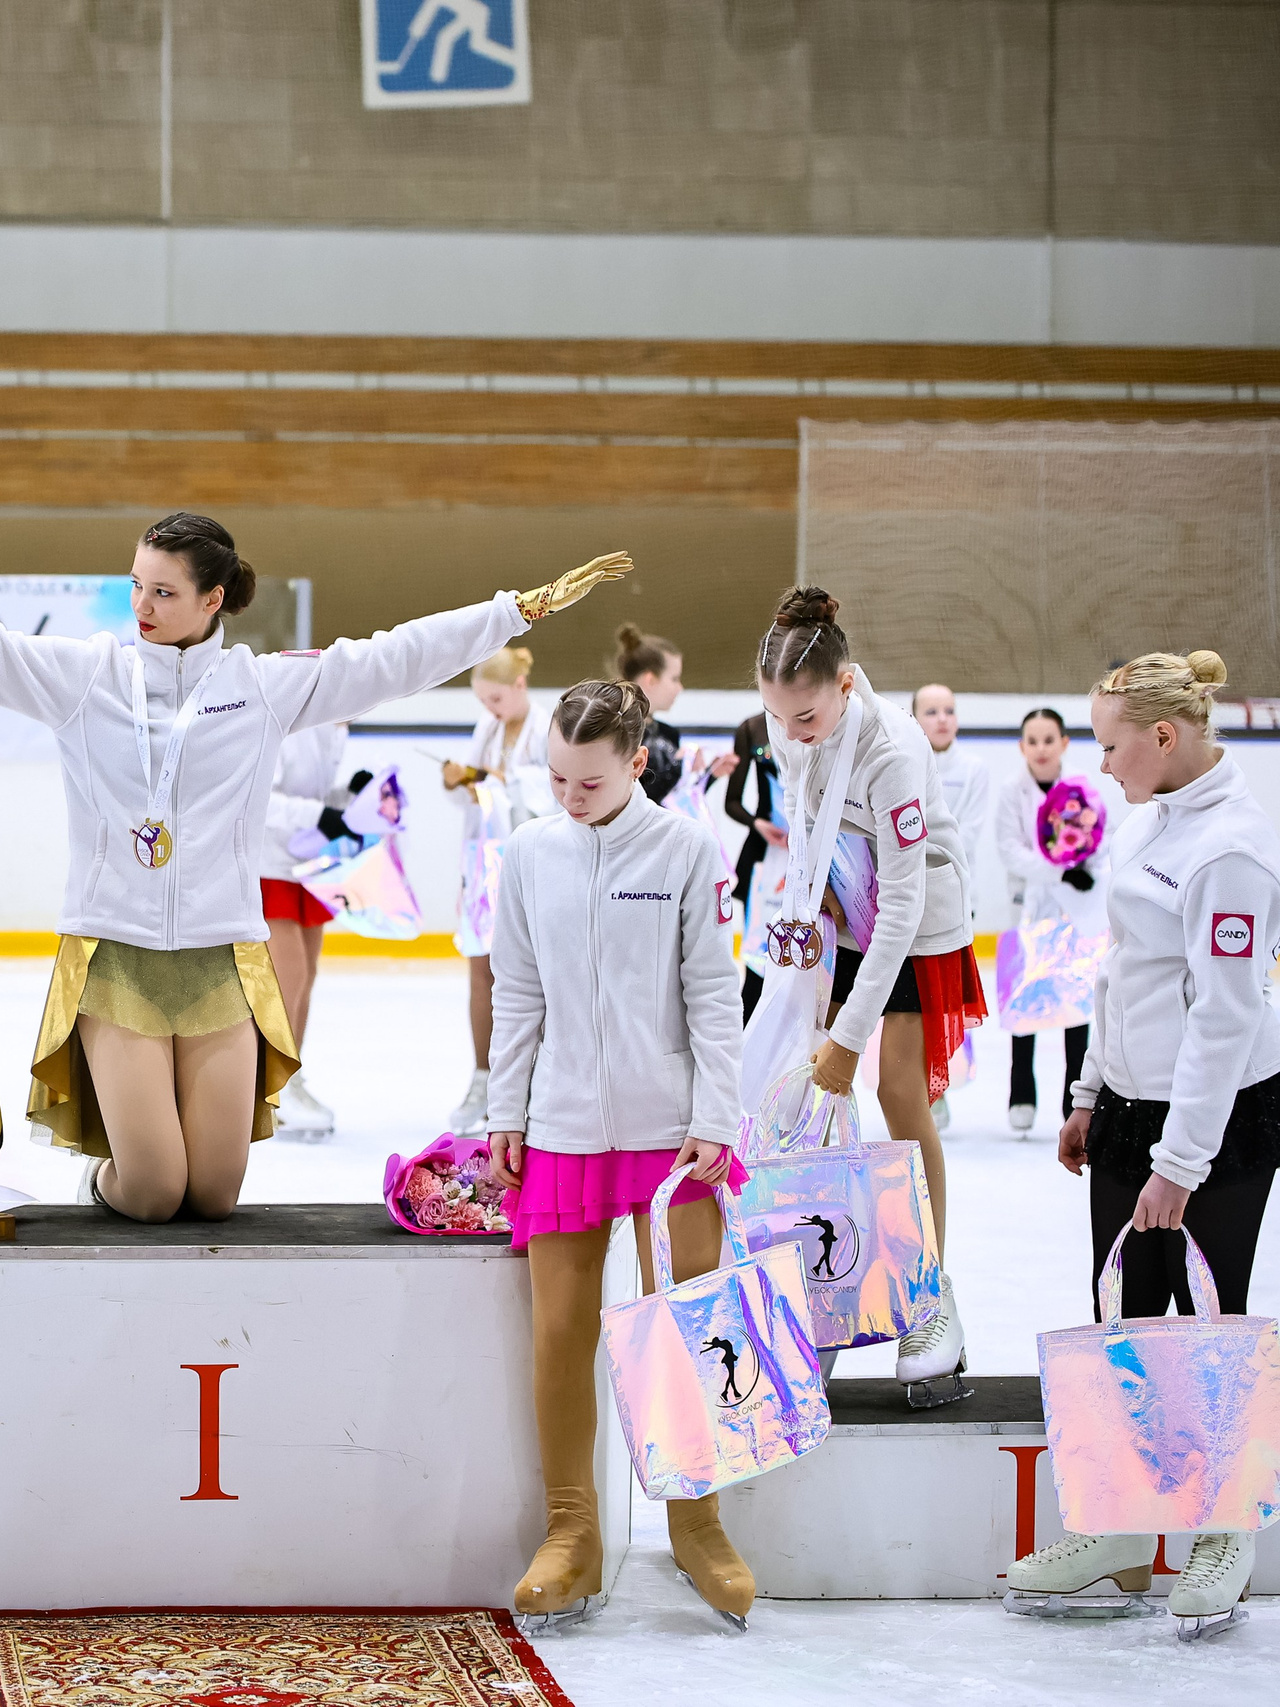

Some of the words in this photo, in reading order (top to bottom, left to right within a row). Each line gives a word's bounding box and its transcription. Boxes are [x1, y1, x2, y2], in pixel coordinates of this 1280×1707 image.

[1217, 929, 1248, 940] CANDY
[808, 1285, 831, 1295] УБОК
[832, 1285, 858, 1294] CANDY
[180, 1363, 239, 1500] I
